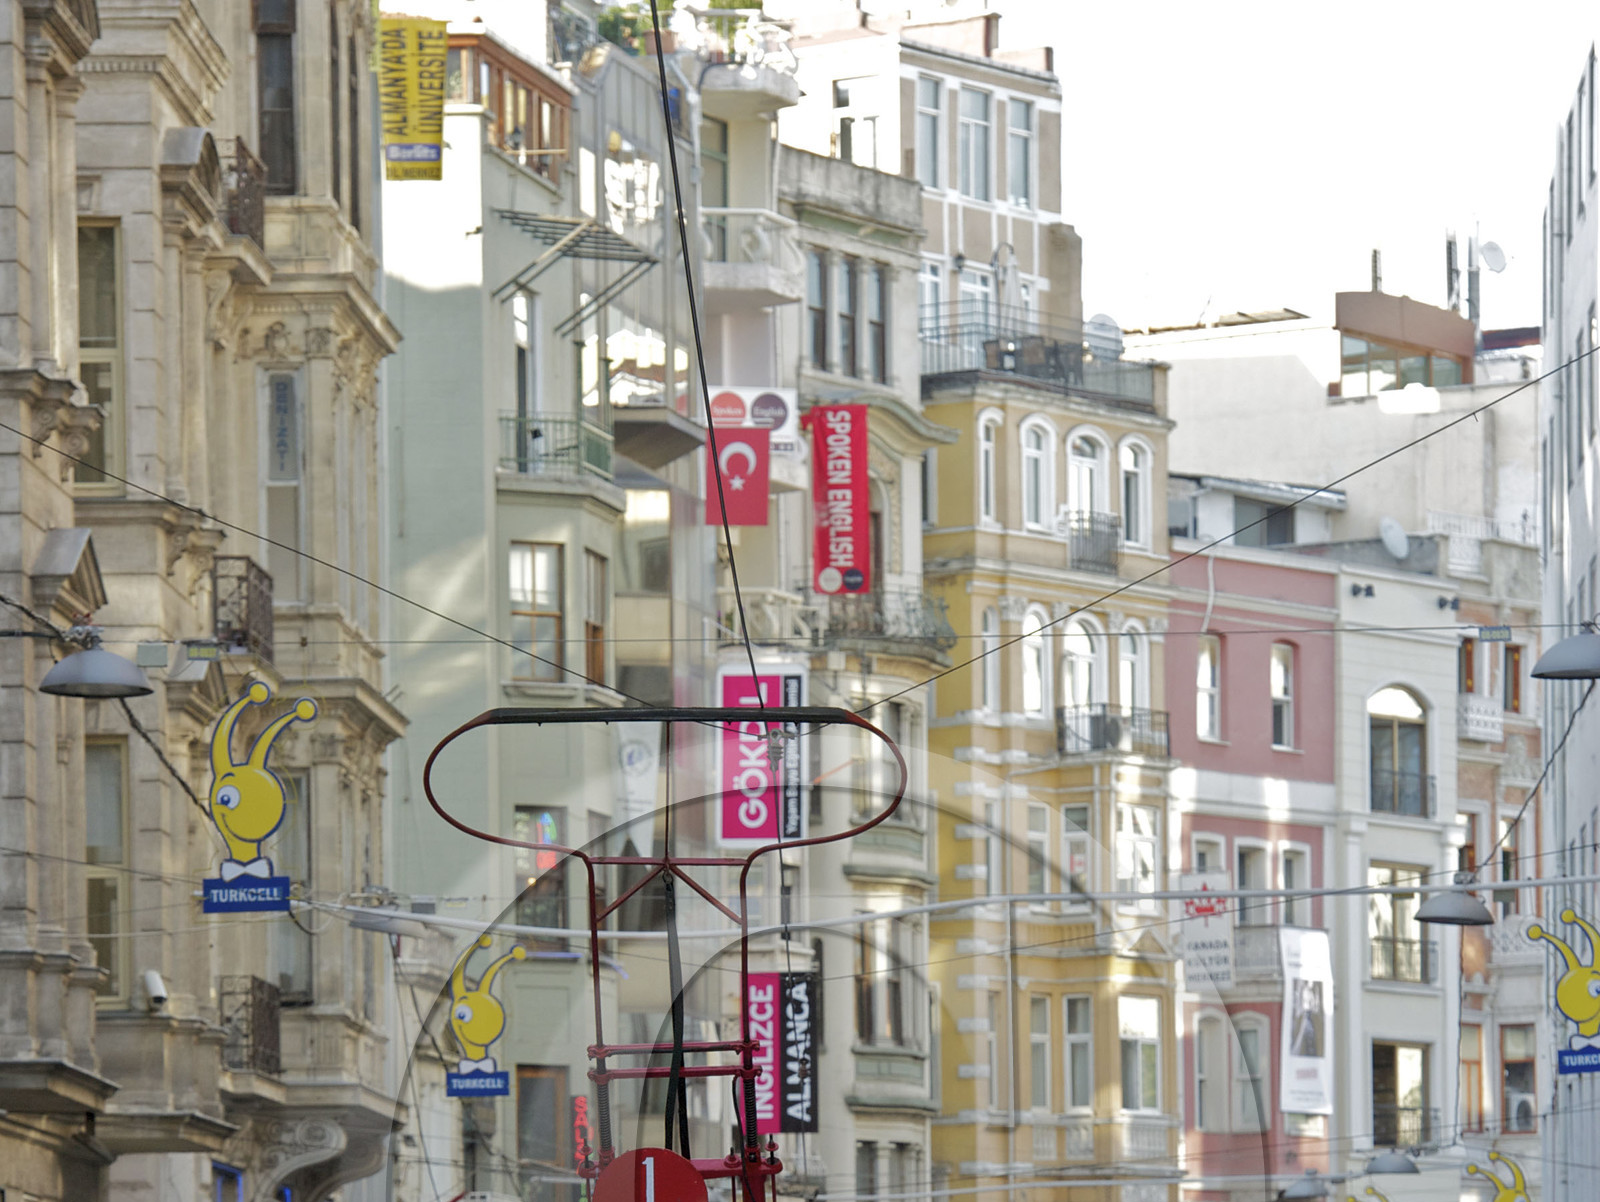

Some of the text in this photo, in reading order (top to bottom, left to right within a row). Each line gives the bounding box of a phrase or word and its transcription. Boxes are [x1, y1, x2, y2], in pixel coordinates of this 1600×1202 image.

[826, 410, 852, 484] SPOKEN
[828, 489, 854, 567] ENGLISH
[732, 682, 768, 829] GÖKDL
[210, 887, 282, 903] TURKCELL
[451, 1078, 504, 1091] TURKCELL
[786, 981, 812, 1122] ALMANCA
[1562, 1053, 1600, 1066] TURKC
